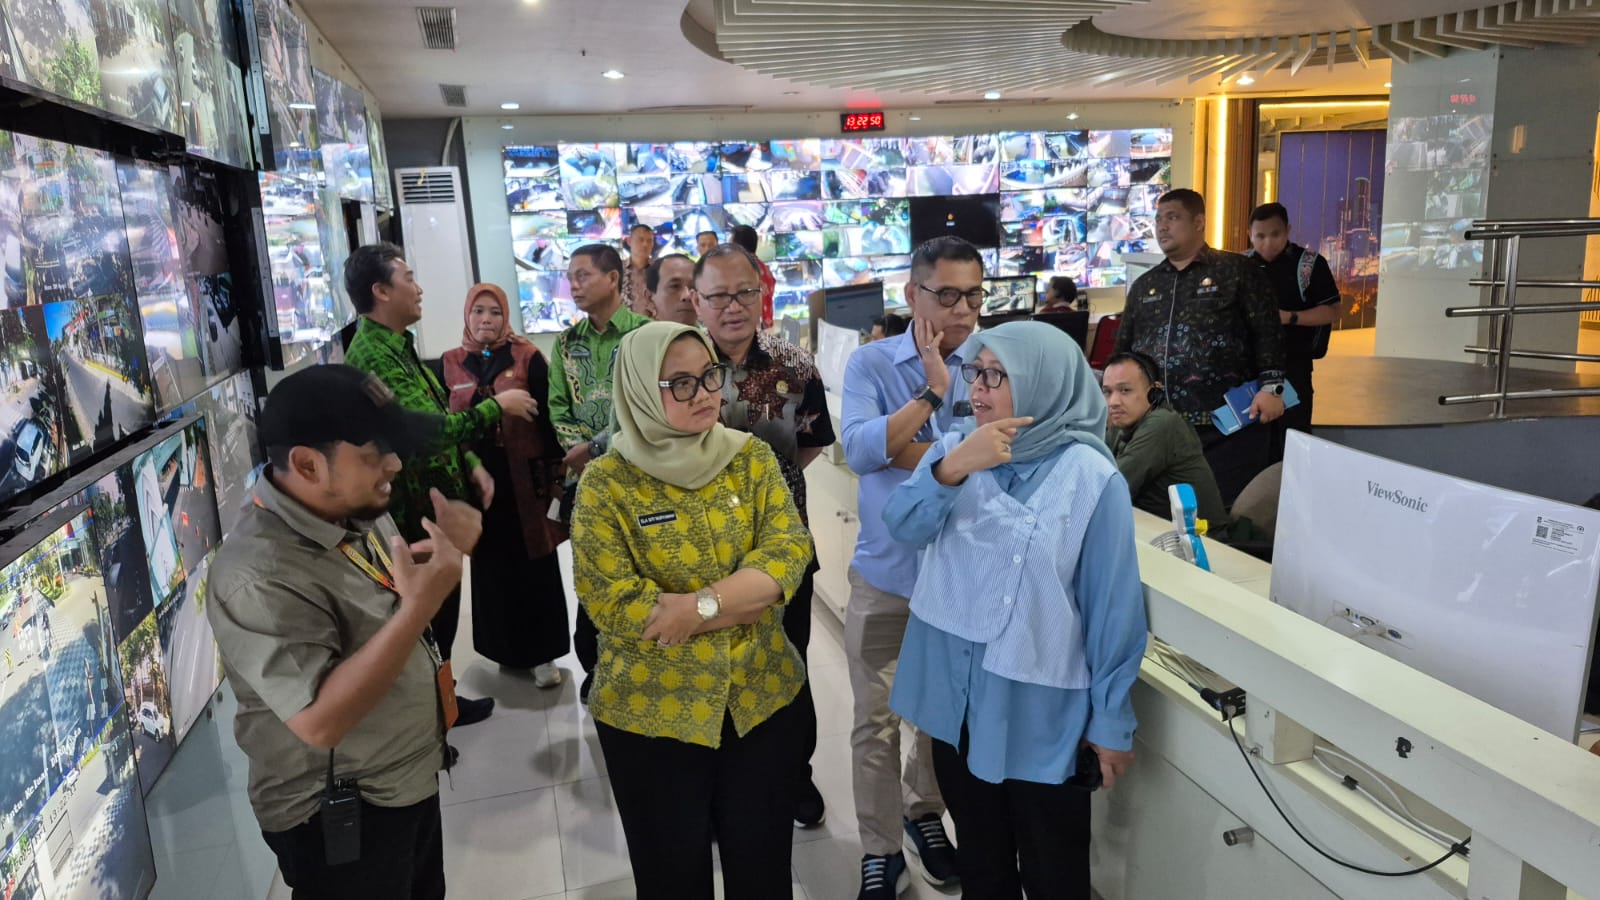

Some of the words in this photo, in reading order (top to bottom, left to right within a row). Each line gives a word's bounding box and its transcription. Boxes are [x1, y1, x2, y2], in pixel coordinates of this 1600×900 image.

[857, 116, 868, 126] 22
[870, 115, 881, 126] 50
[1368, 480, 1428, 512] ViewSonic
[24, 768, 48, 800] Keluar
